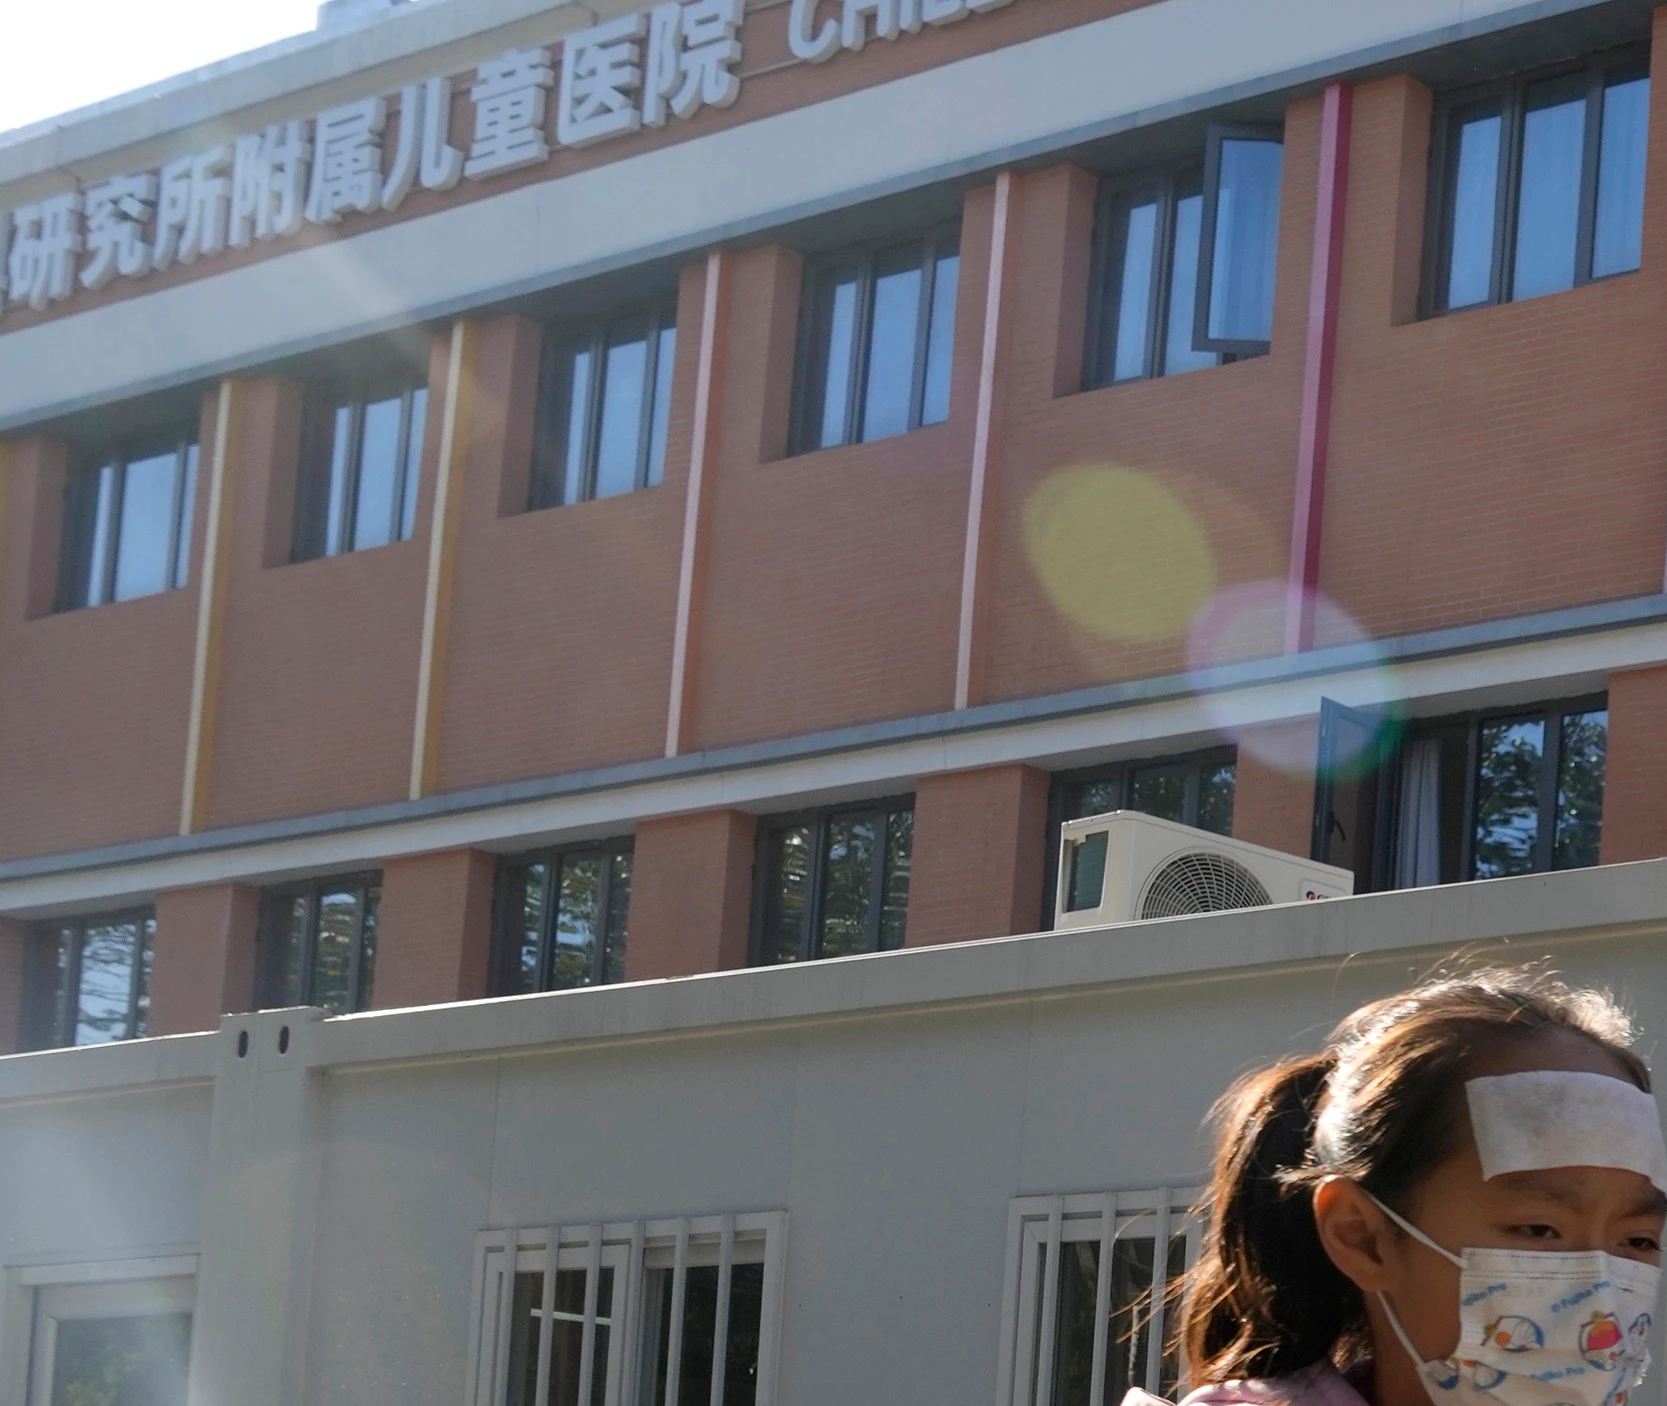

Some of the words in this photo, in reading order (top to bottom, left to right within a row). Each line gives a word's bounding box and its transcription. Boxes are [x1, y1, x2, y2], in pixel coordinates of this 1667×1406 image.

[0, 0, 744, 310] 研究所附属儿童医院
